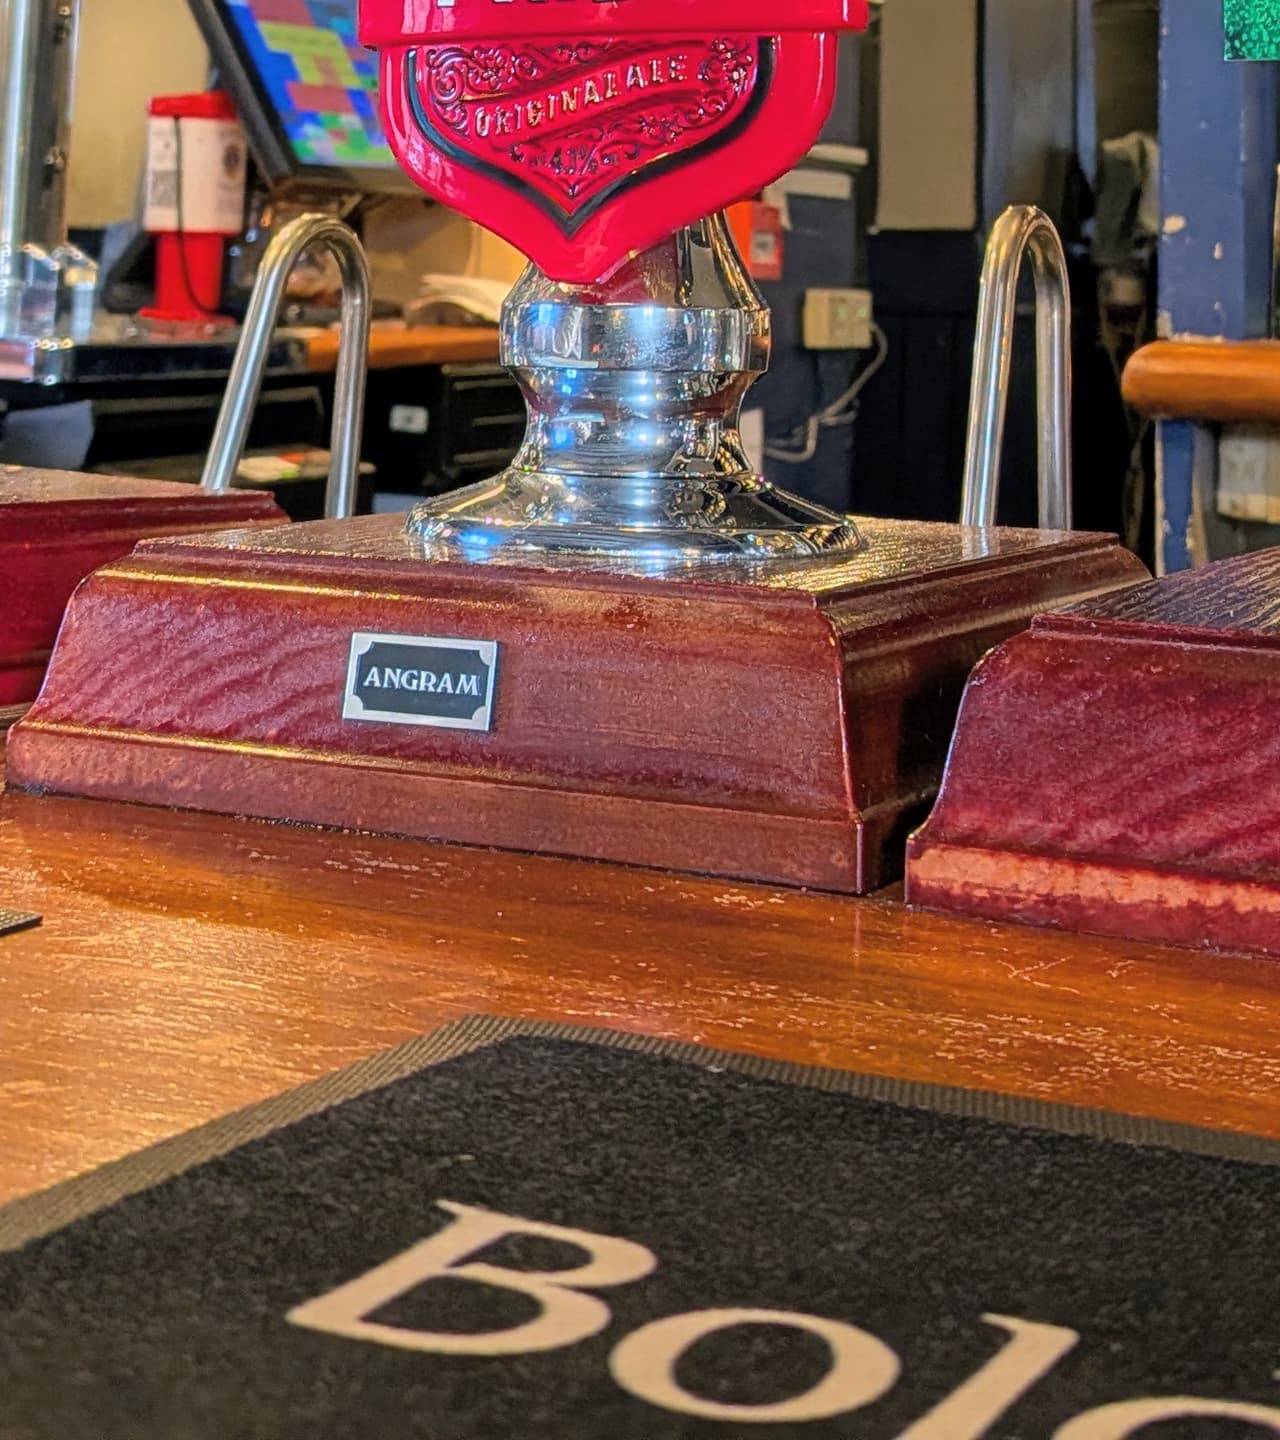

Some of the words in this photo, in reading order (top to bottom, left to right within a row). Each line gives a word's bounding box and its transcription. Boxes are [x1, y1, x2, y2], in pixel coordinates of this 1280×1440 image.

[475, 71, 622, 137] ORIGINAL
[626, 55, 688, 91] ALE
[363, 666, 482, 697] ANGRAM
